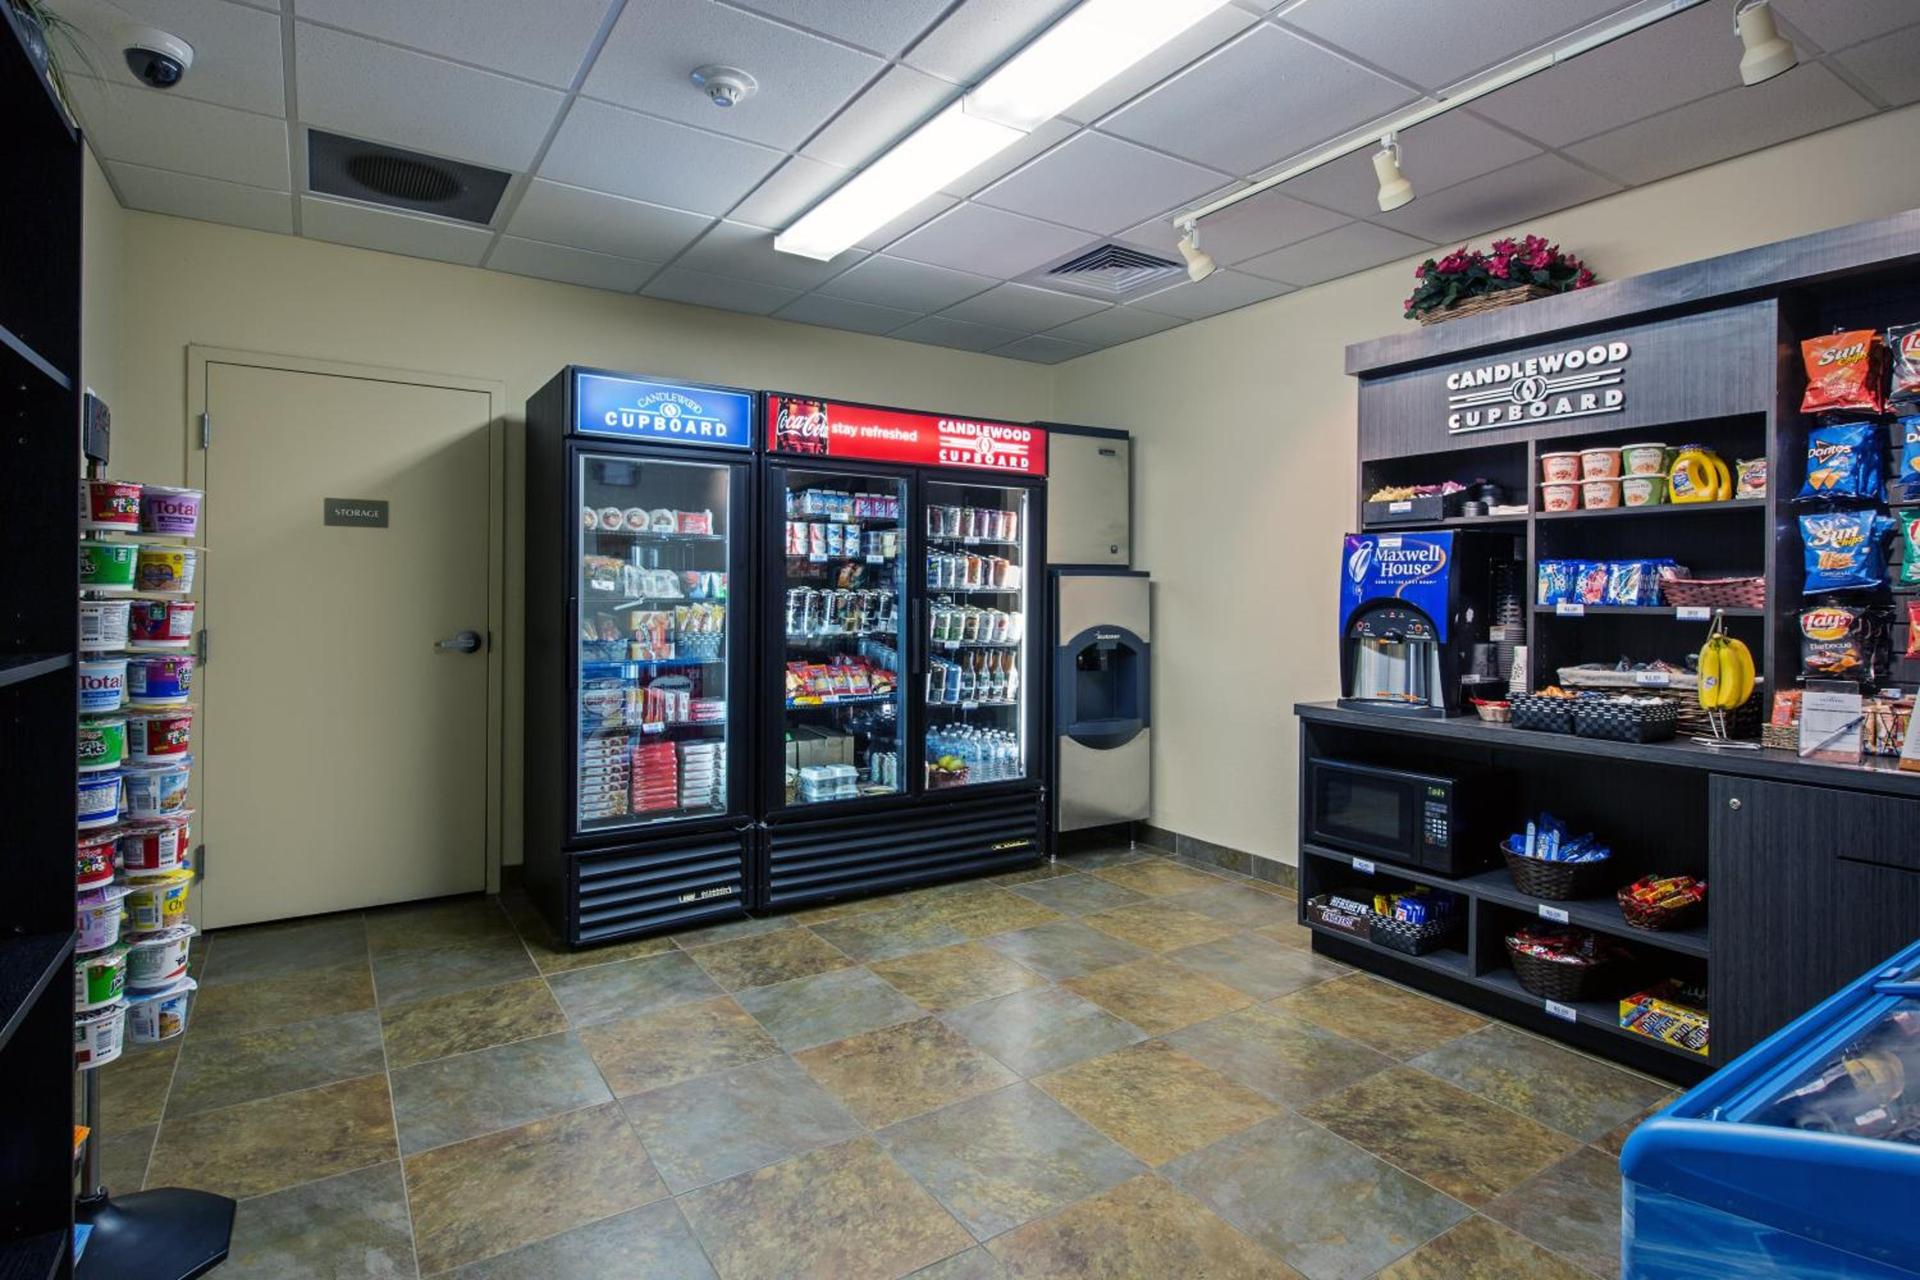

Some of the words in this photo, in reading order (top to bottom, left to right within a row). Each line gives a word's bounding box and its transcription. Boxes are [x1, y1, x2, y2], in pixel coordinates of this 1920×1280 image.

[1447, 342, 1629, 390] CANDLEWOOD
[637, 391, 703, 415] CANDLEWOOD
[1448, 389, 1624, 429] CUPBOARD
[604, 411, 728, 437] CUPBOARD
[831, 421, 857, 439] stay
[861, 425, 918, 442] refreshed
[938, 420, 1031, 442] CANDLEWOOD
[939, 449, 1029, 468] CUPBOARD
[1808, 444, 1852, 459] Doritos
[154, 500, 198, 516] Total
[334, 508, 380, 518] STORAGE
[1375, 544, 1441, 561] Maxwell
[1380, 562, 1432, 577] House
[79, 674, 124, 690] Total
